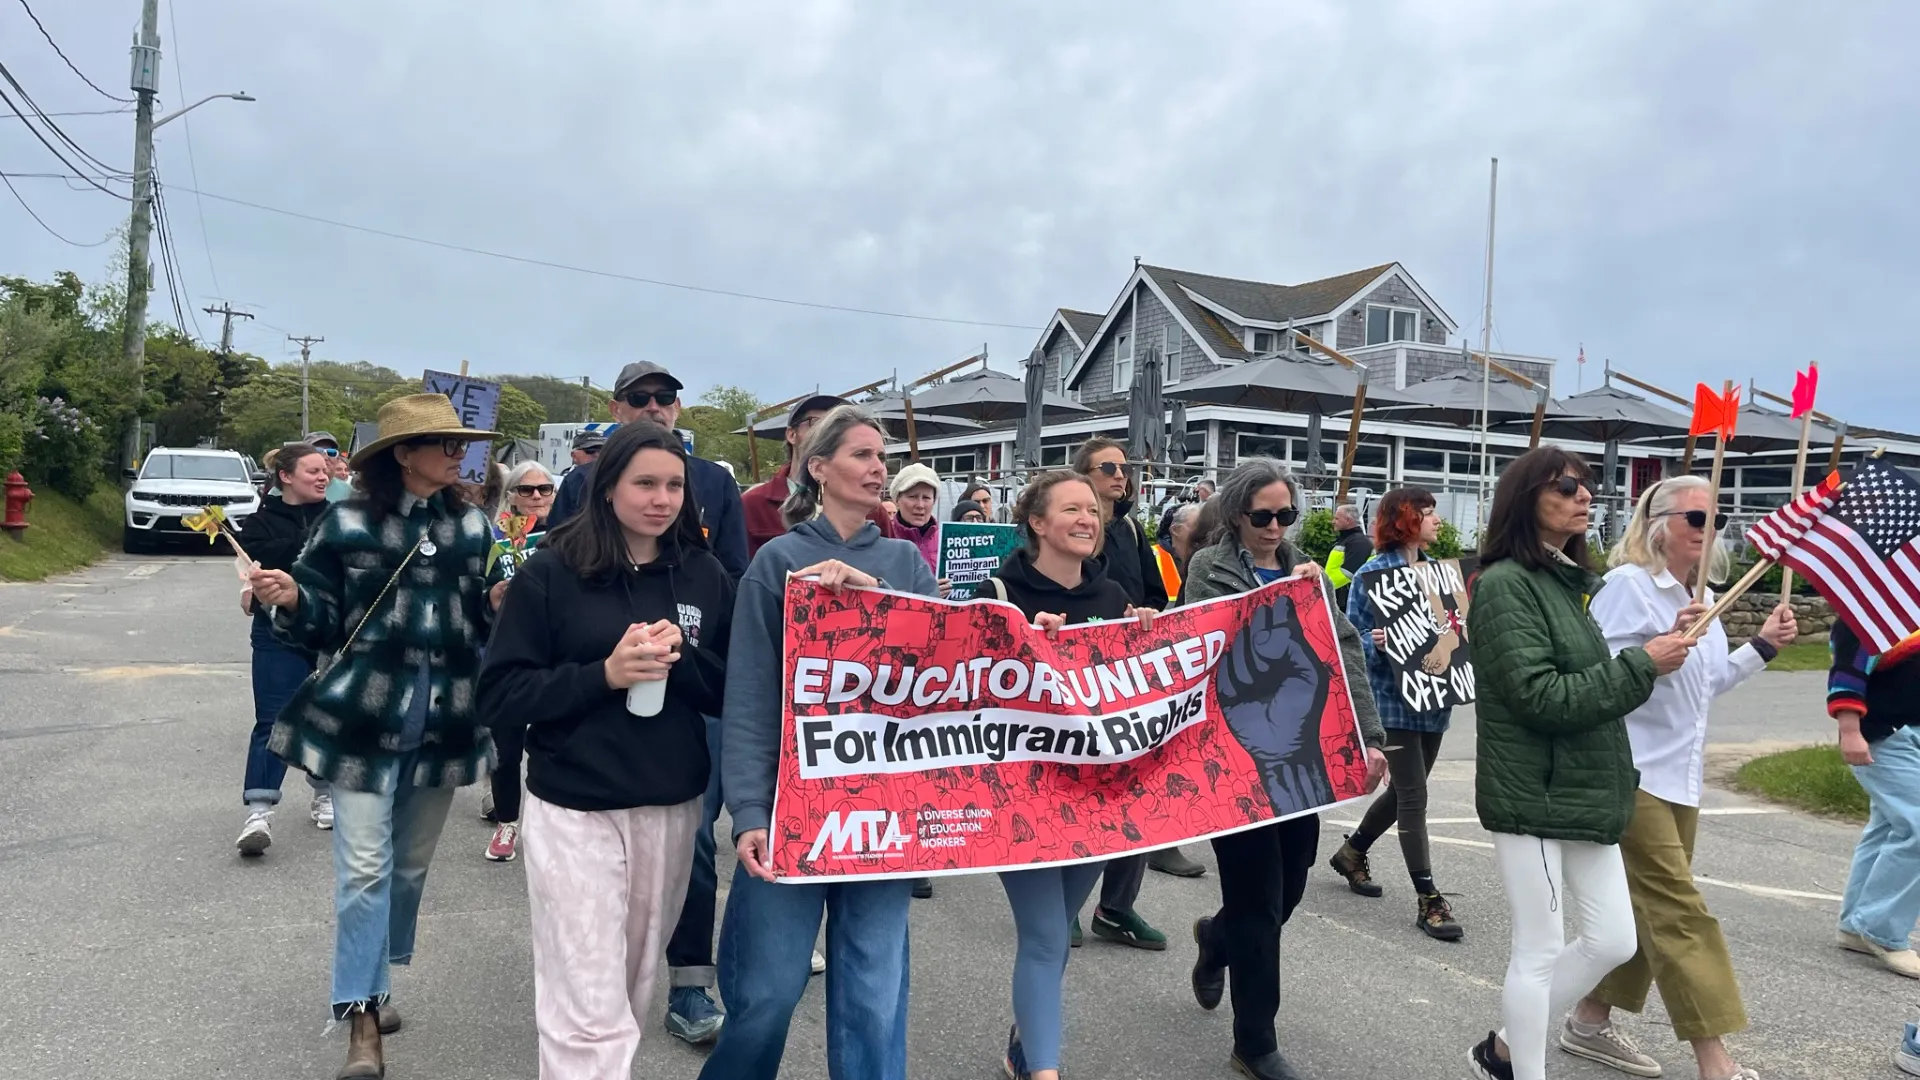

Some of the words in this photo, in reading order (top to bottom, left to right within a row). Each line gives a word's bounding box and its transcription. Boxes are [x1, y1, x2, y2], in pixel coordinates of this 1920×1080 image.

[947, 535, 995, 547] PROTECT
[947, 548, 970, 559] OUR
[948, 558, 998, 571] Immigrant
[948, 572, 988, 582] Families
[946, 589, 971, 600] MTA
[1368, 567, 1418, 618] KEEP
[1414, 563, 1464, 596] YOUR
[1384, 591, 1433, 665] CHAINS
[794, 656, 1076, 707] EDUCATORS
[1067, 630, 1226, 708] UNITED
[1402, 670, 1448, 713] OFF
[803, 720, 876, 767] For
[883, 712, 1101, 762] Immigrant
[1101, 690, 1204, 756] Rights
[916, 811, 923, 821] A
[924, 809, 964, 821] DIVERSE
[965, 808, 993, 819] UNION
[806, 811, 913, 862] MTA
[918, 824, 927, 838] of
[930, 822, 982, 834] EDUCATION
[920, 836, 967, 848] WORKERS
